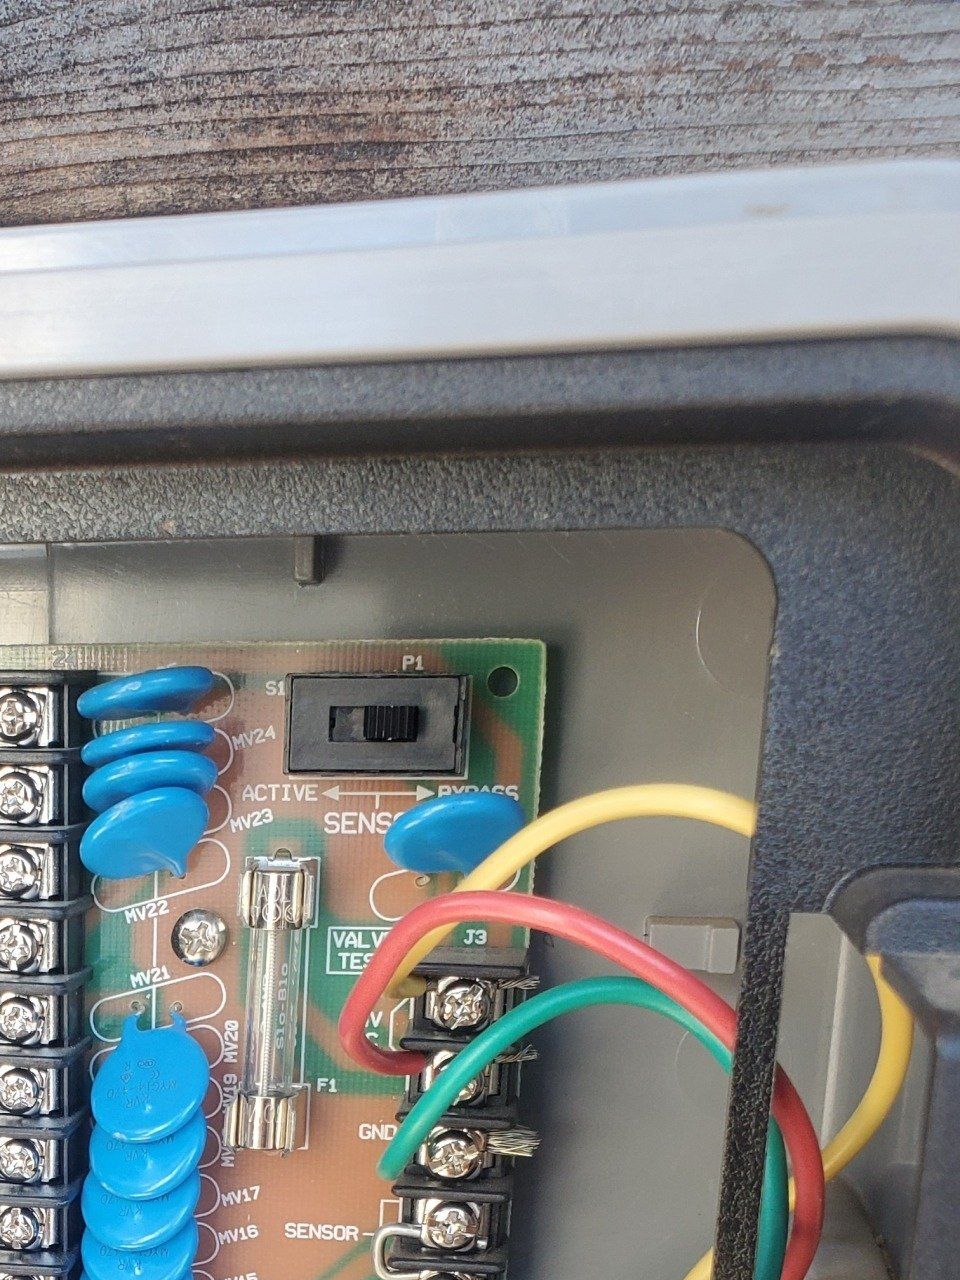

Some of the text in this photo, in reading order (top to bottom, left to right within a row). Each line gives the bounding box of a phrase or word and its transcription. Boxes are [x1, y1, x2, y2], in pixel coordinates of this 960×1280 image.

[402, 655, 424, 670] P1
[265, 681, 286, 696] S1
[232, 725, 276, 750] MV24
[242, 784, 318, 802] ACTIVE
[230, 808, 274, 833] MV23
[124, 900, 170, 924] MV22
[332, 931, 390, 949] VALV
[463, 929, 488, 945] J3
[338, 952, 374, 970] TES
[130, 965, 171, 989] MV21
[223, 1020, 239, 1063] MV20
[316, 1078, 338, 1093] F1
[358, 1123, 398, 1140] GND
[221, 1185, 261, 1207] MV17
[219, 1224, 259, 1245] MV16
[284, 1223, 359, 1241] SENSOR
